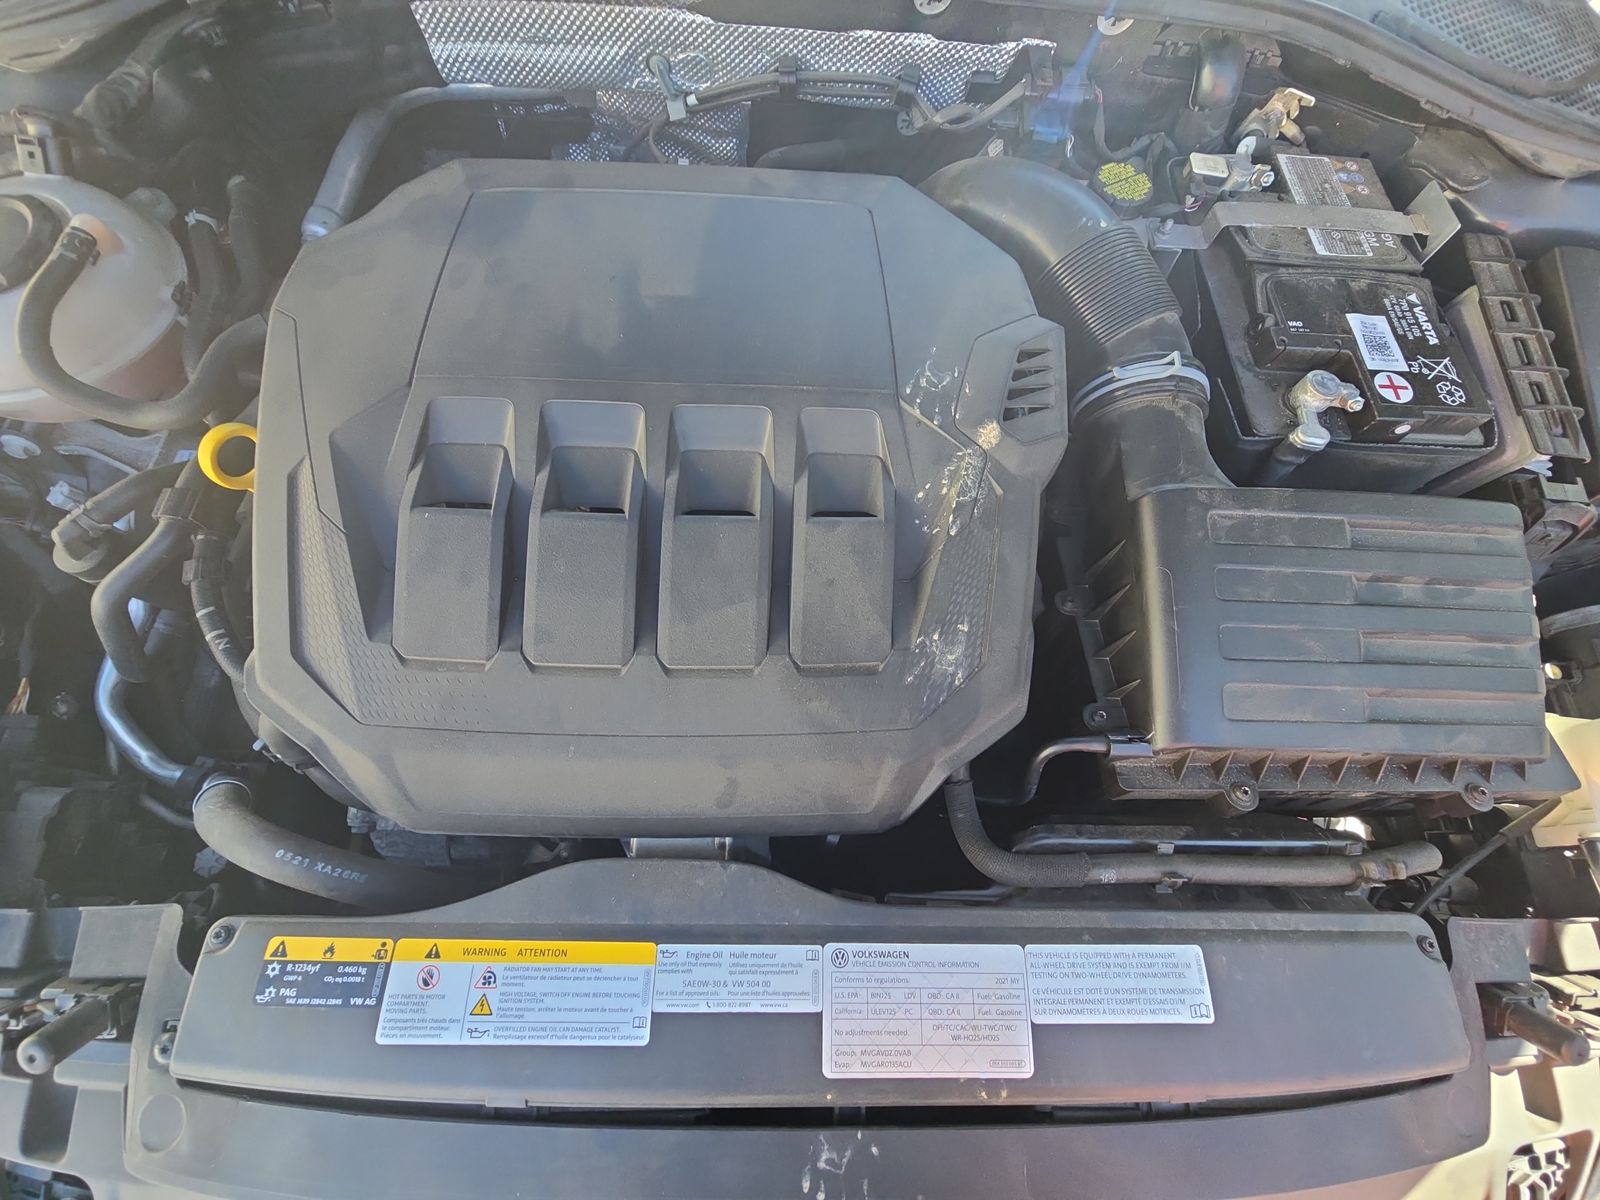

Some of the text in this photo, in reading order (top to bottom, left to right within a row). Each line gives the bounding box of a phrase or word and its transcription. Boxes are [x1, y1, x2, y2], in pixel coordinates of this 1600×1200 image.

[1381, 234, 1397, 248] AG
[1404, 312, 1415, 323] 915
[1411, 325, 1422, 336] 105
[1413, 306, 1440, 346] VARTA
[1408, 361, 1420, 373] Pb
[275, 849, 310, 868] 0521
[463, 947, 567, 957] WARNING ATTENTION
[686, 951, 723, 960] Engine Oil
[852, 950, 910, 959] VOLKSWAGEN
[1080, 952, 1111, 960] EQUIPPED
[286, 964, 321, 974] R-1234yf
[358, 966, 367, 975] kg
[746, 980, 759, 988] 504
[762, 980, 771, 988] 00
[279, 988, 297, 996] PAG
[1041, 987, 1072, 995] VÉHICULE
[845, 1029, 882, 1037] adjustments
[835, 1048, 856, 1058] Group:
